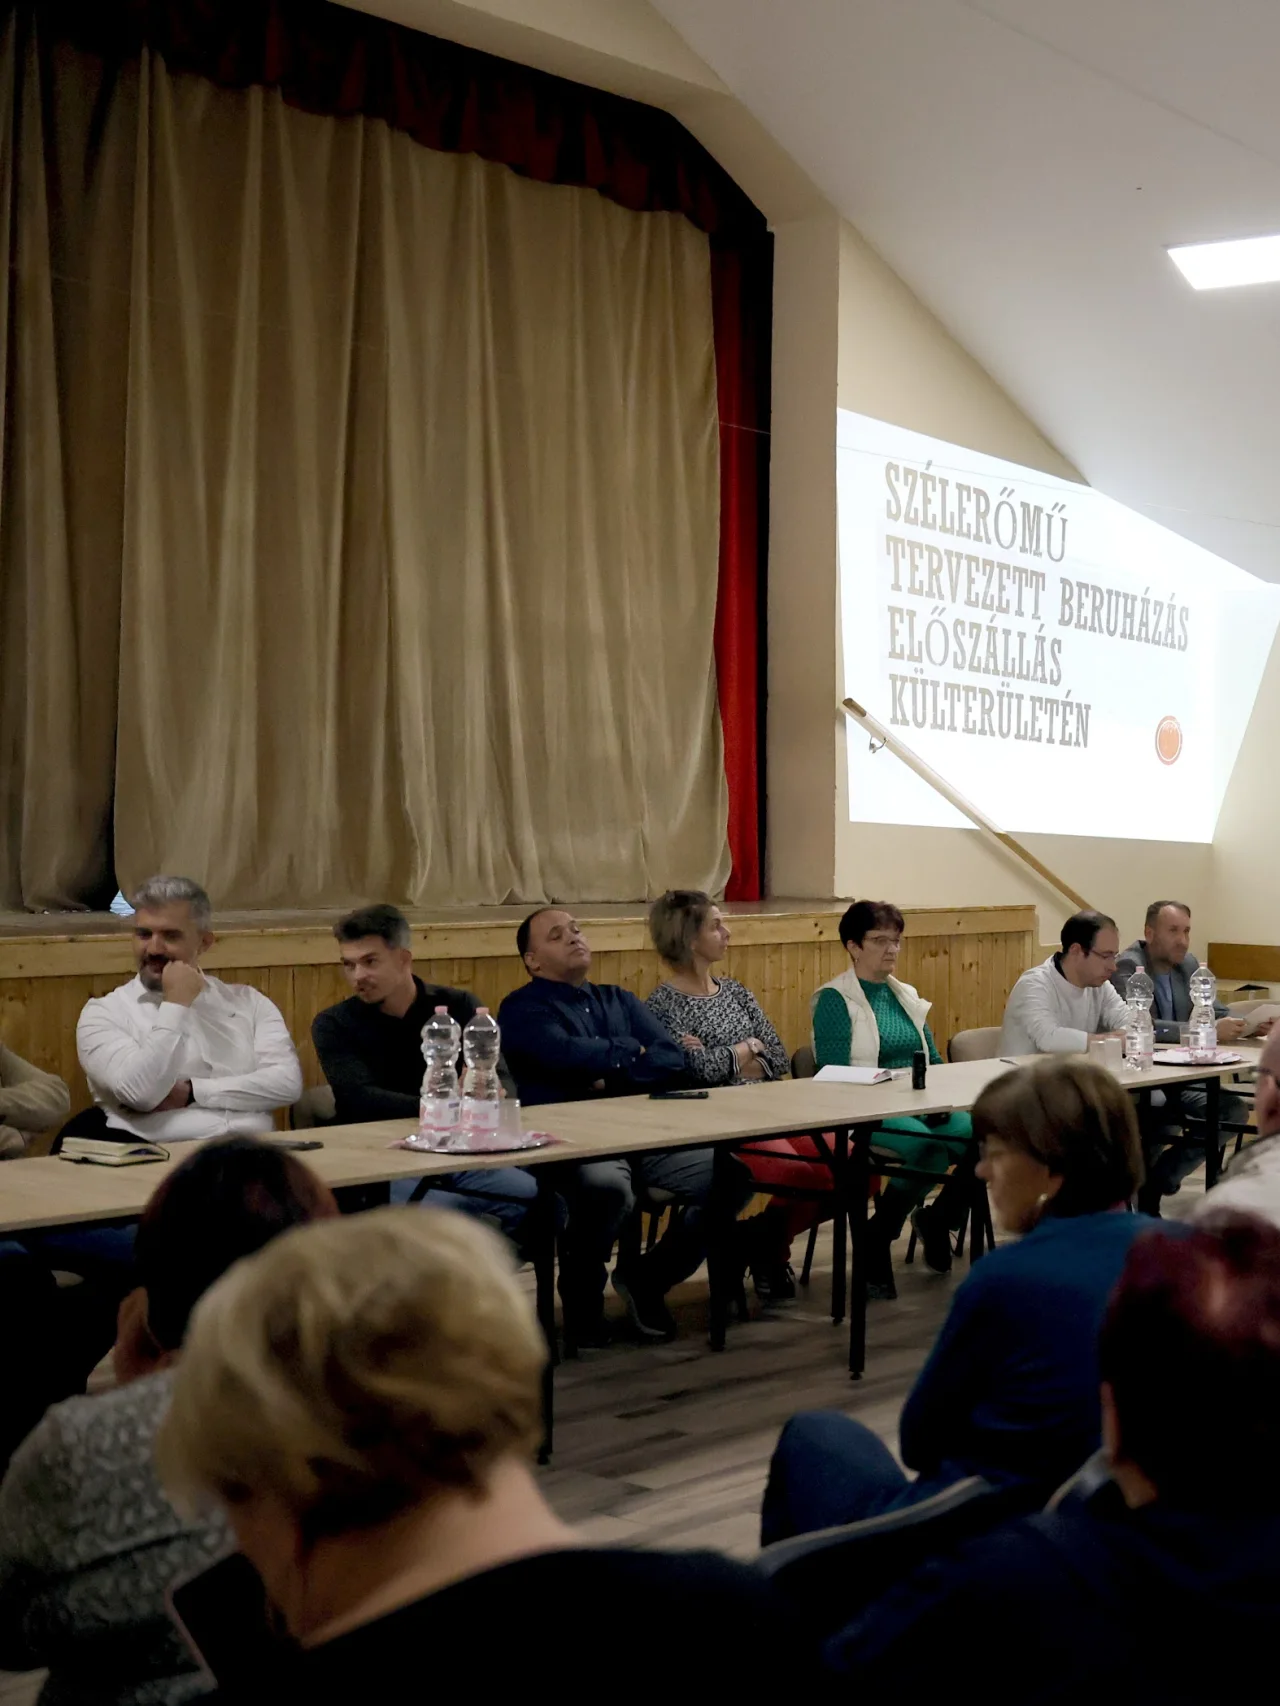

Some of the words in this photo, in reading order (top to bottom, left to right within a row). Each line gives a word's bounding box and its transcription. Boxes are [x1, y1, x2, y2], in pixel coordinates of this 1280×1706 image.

[886, 460, 1068, 562] SZÉLERŐMŰ
[886, 535, 1046, 620] TERVEZETT
[1058, 577, 1189, 652] BERUHÁZÁS
[888, 606, 1062, 687] ELŐSZÁLLÁS
[889, 667, 1091, 748] KÜLTERÜLETÉN
